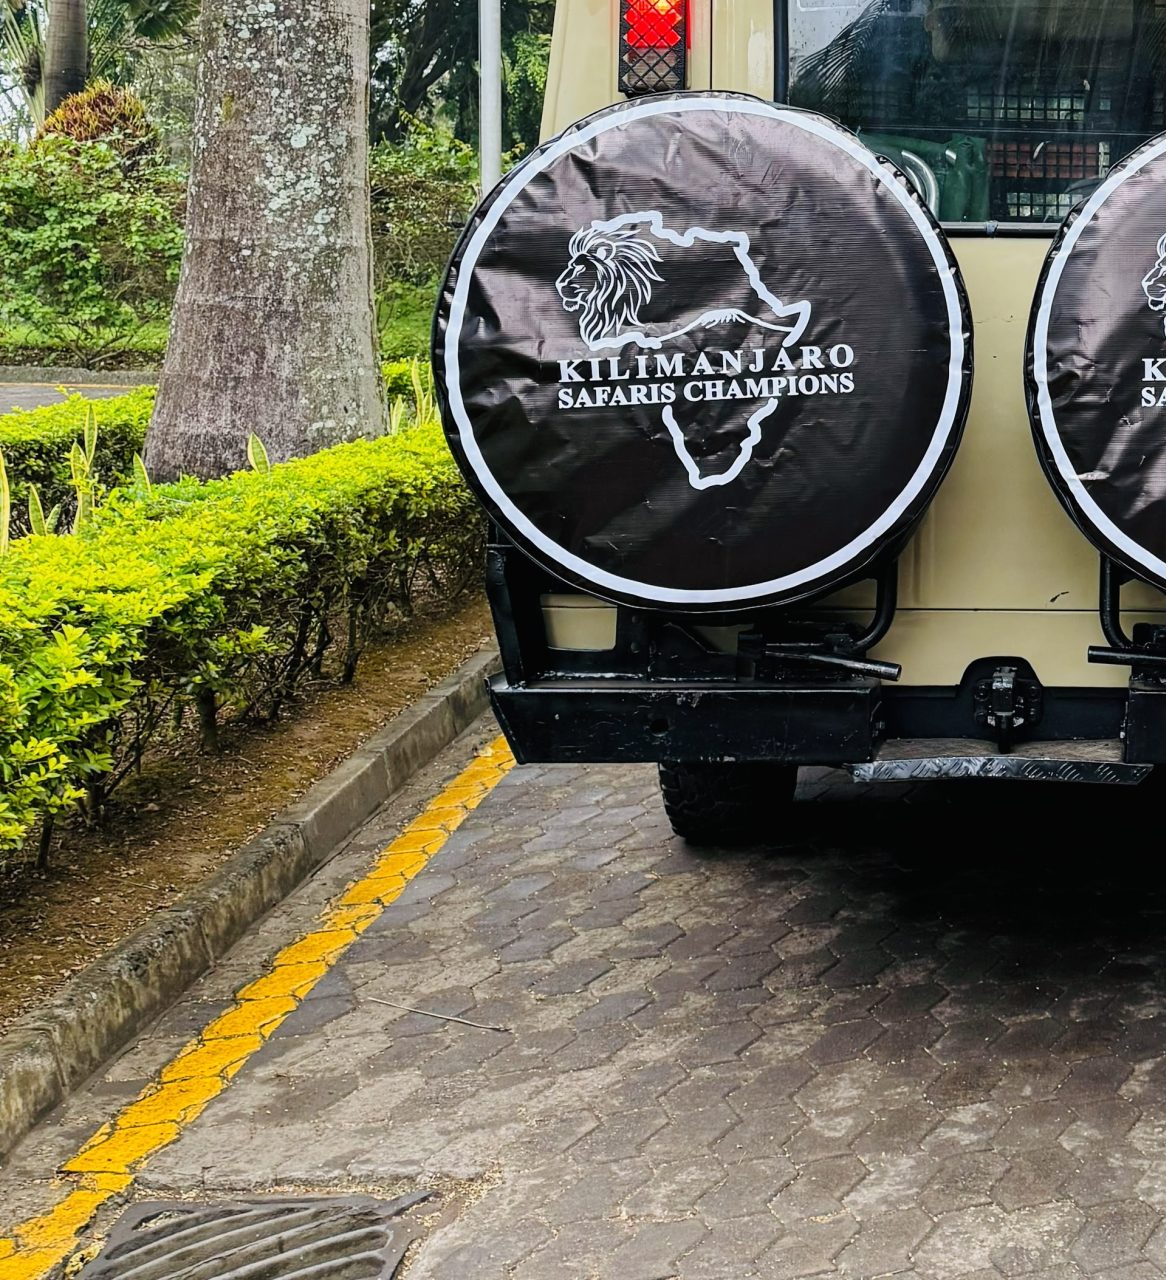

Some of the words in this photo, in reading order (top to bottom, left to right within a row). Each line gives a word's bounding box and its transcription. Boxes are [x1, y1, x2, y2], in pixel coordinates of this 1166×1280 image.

[556, 343, 855, 383] KILIMANJARO
[558, 382, 676, 409] SAFARIS
[683, 372, 855, 402] CHAMPIONS
